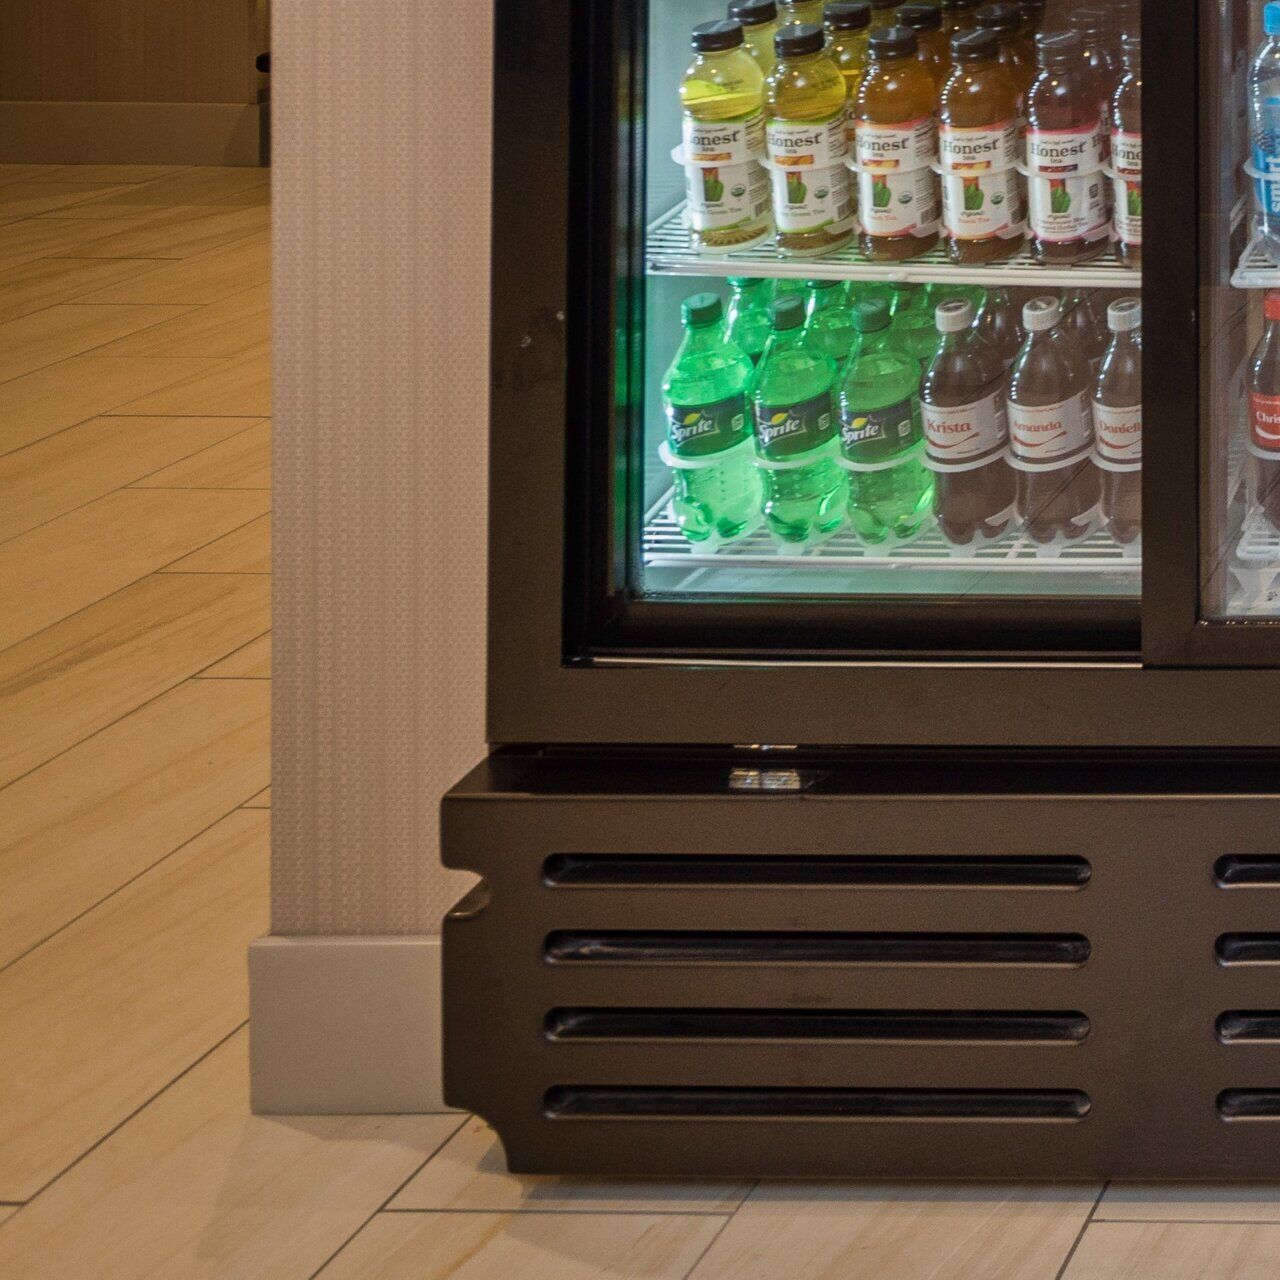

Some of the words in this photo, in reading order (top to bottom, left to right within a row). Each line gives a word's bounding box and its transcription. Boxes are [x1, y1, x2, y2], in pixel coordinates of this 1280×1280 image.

[856, 136, 911, 152] Honest
[944, 137, 1001, 155] Honest
[1031, 140, 1087, 158] Honest
[671, 419, 713, 441] Sprite
[759, 419, 801, 442] Sprite
[842, 422, 880, 443] Sprite
[927, 419, 972, 434] Krista
[1013, 420, 1063, 433] Amanda
